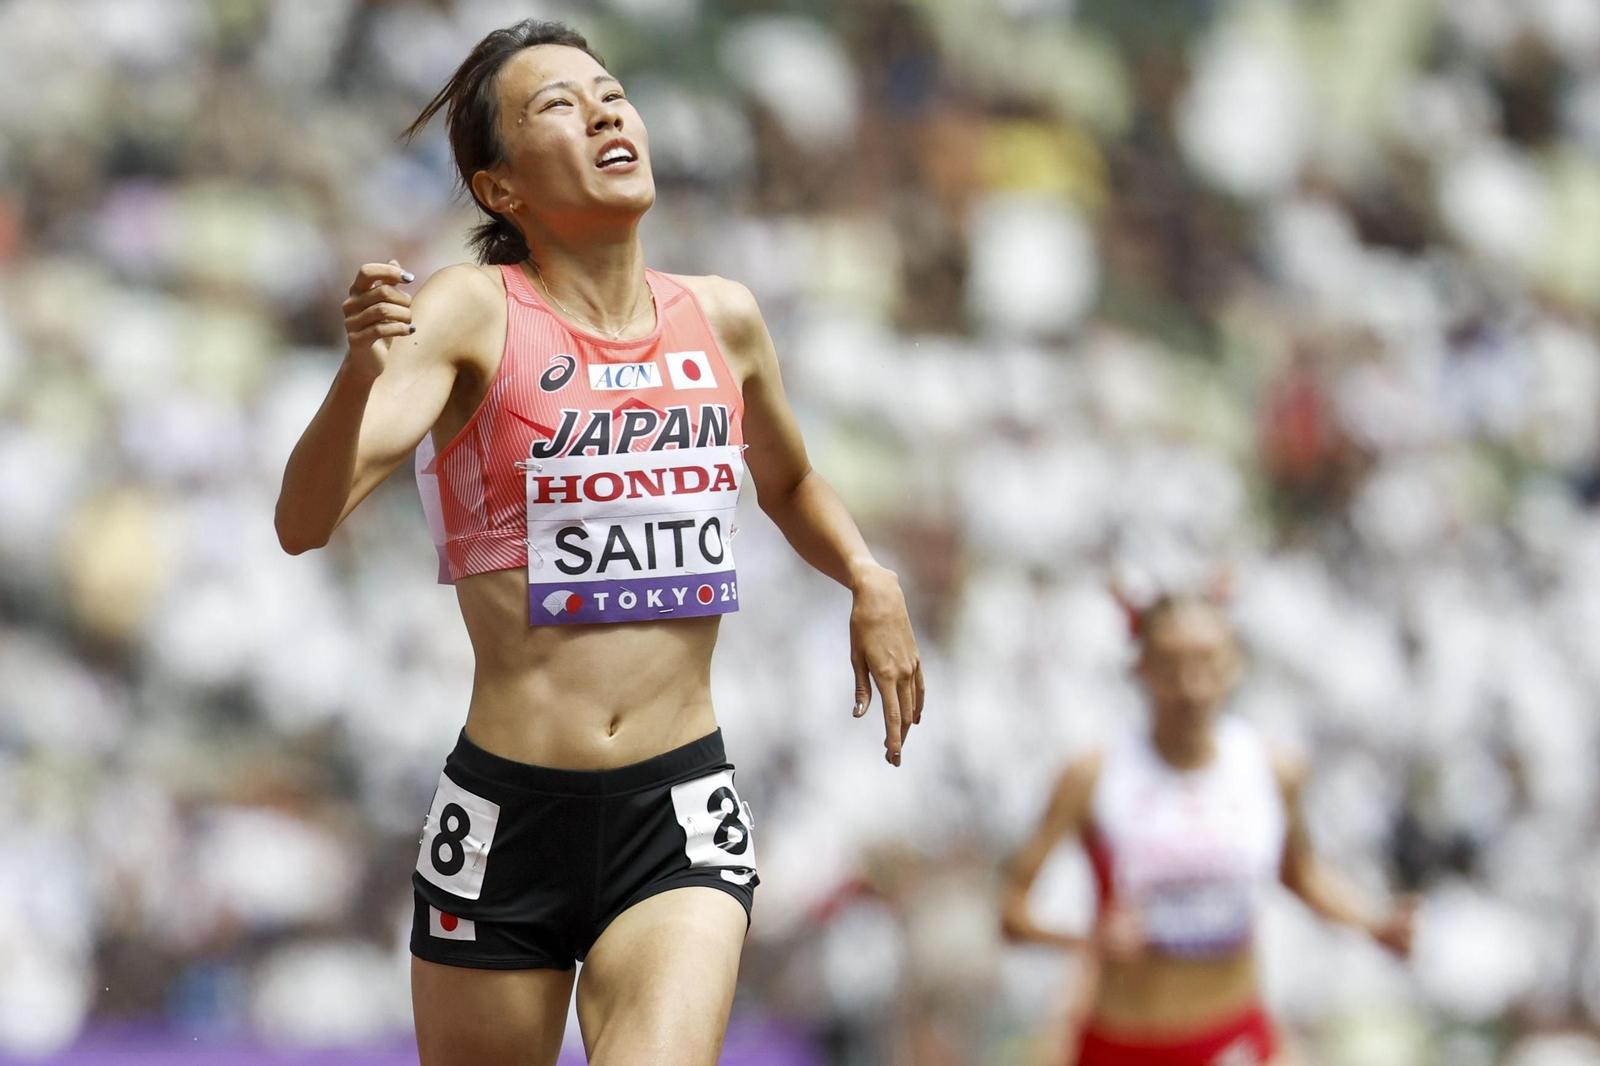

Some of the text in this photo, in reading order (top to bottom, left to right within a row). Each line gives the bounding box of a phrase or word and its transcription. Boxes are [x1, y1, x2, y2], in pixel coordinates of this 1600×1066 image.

[595, 364, 653, 388] ACN
[531, 404, 731, 459] JAPAN
[532, 463, 738, 504] HONDA
[554, 516, 725, 576] SAITO
[720, 581, 737, 602] 25
[430, 802, 471, 876] 8
